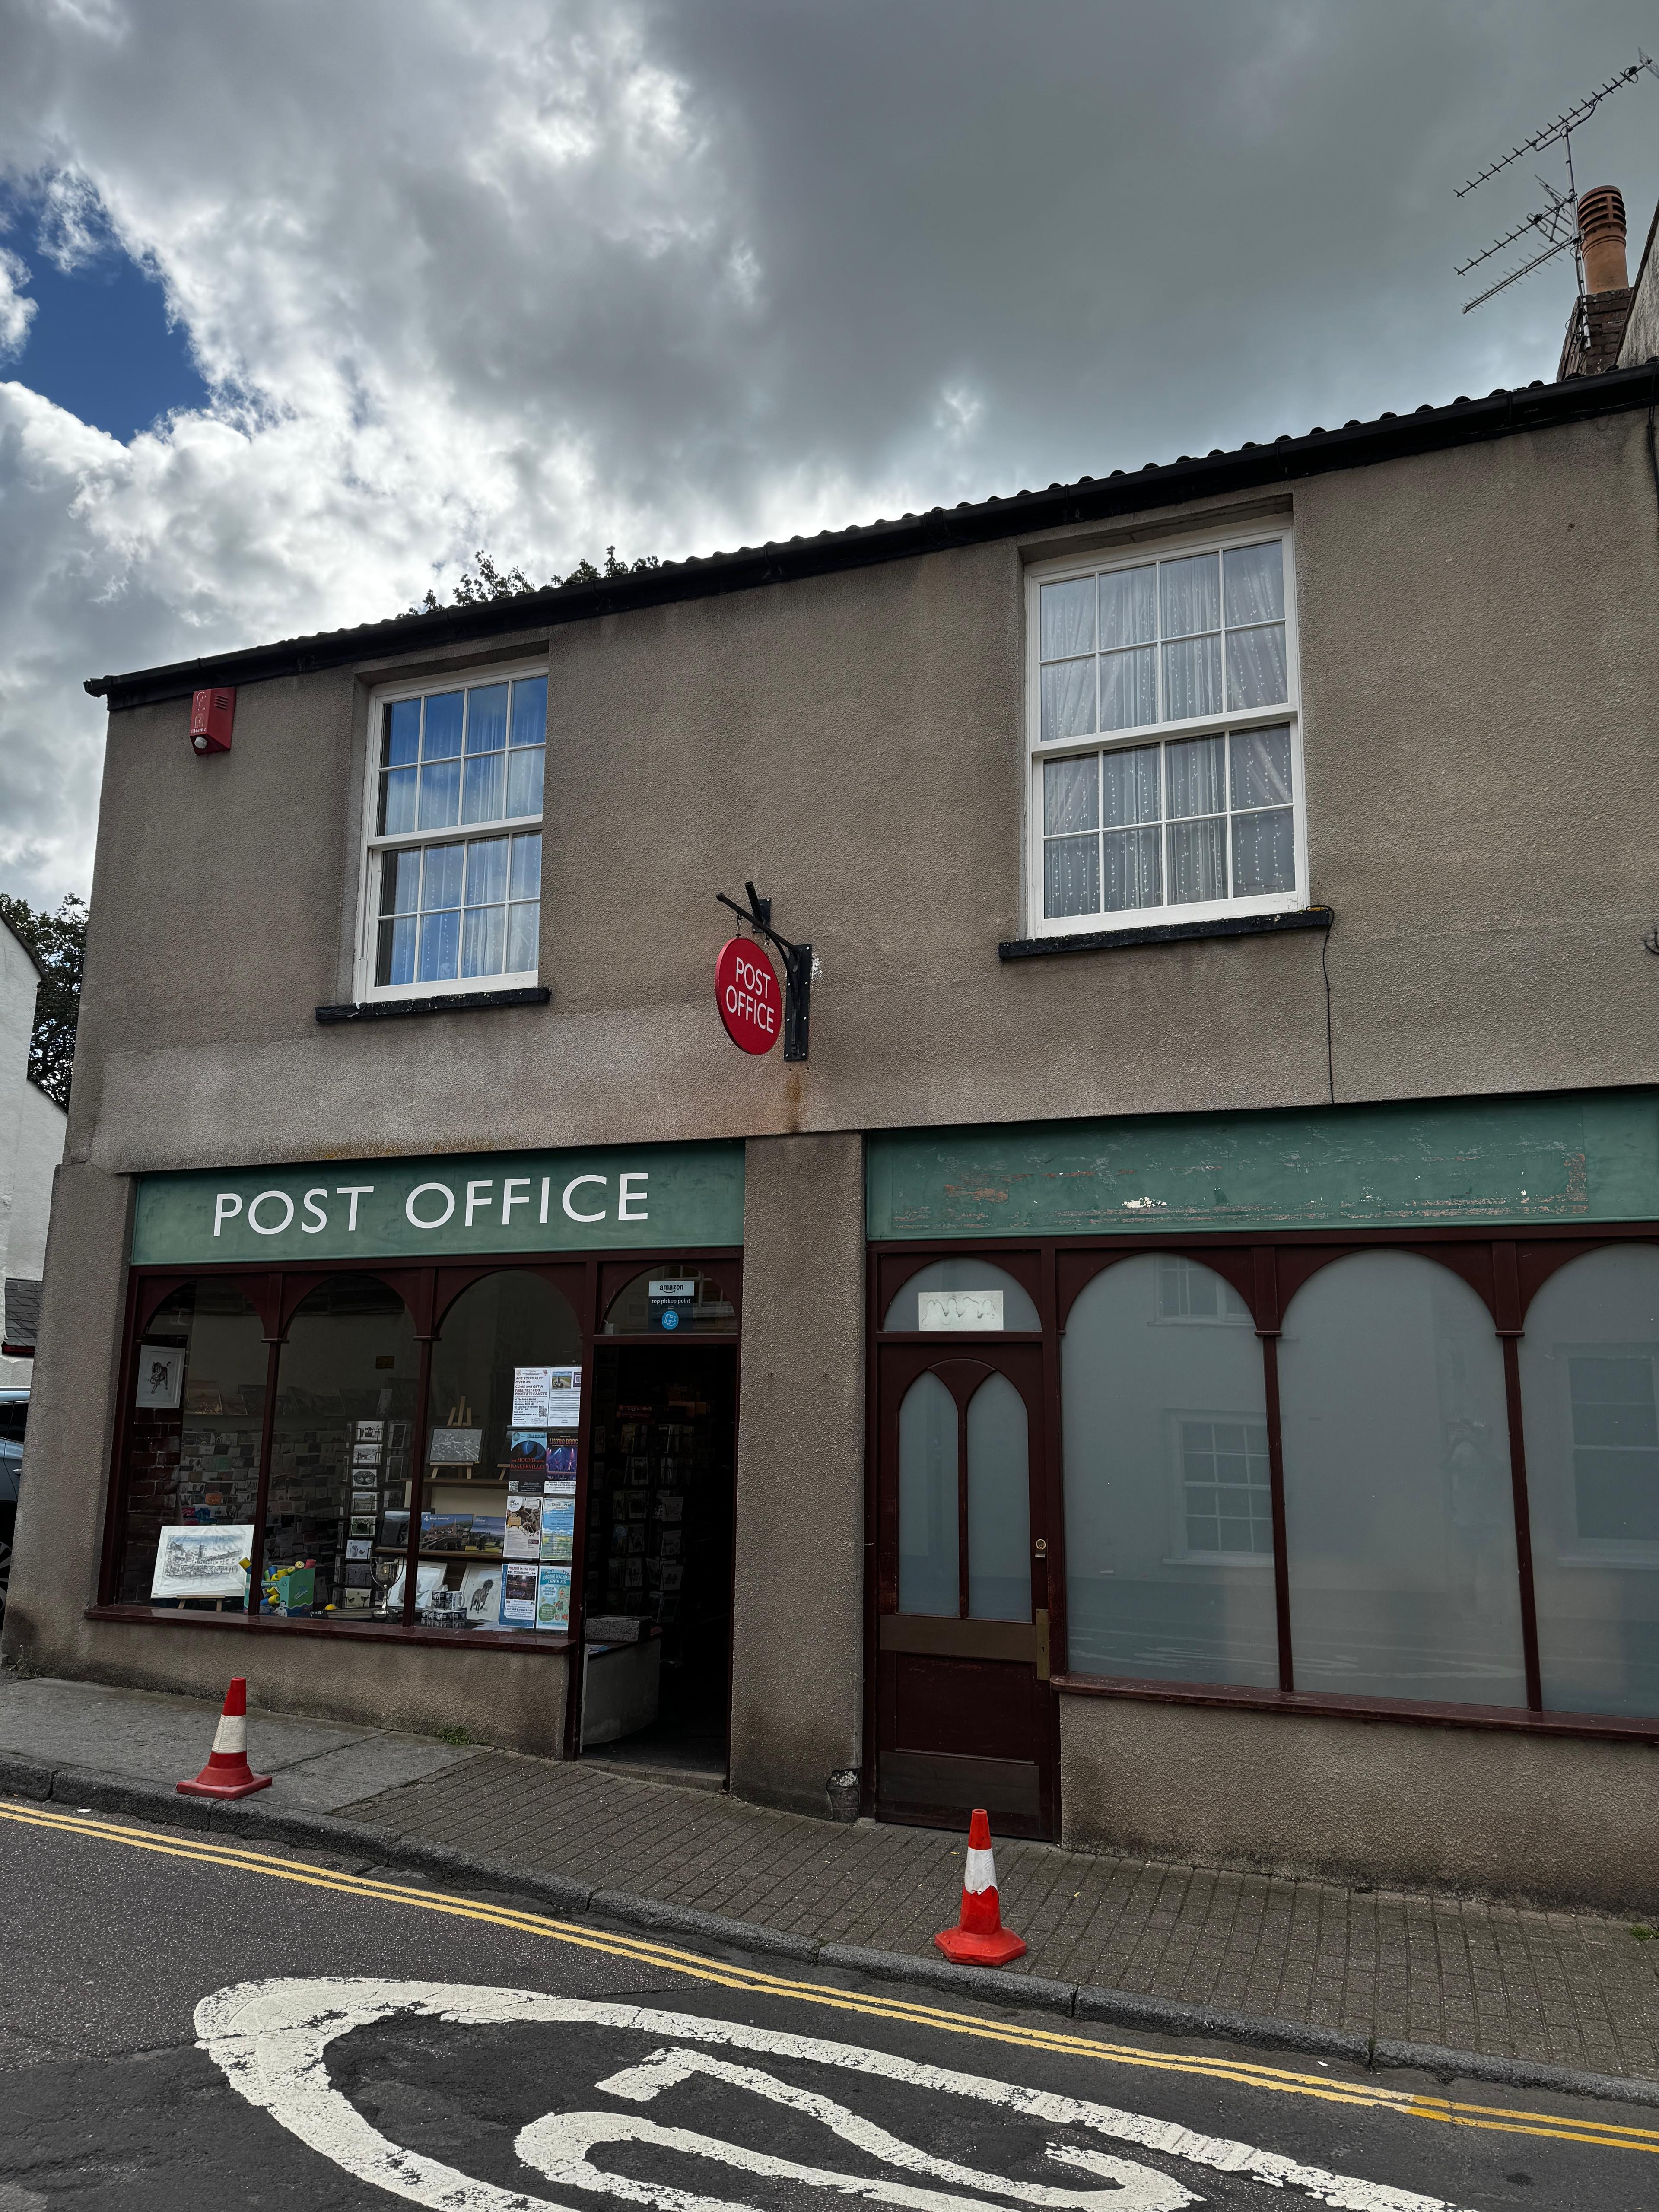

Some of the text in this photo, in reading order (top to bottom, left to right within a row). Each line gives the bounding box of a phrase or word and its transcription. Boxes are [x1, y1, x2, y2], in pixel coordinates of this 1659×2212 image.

[735, 957, 771, 999] POST
[725, 986, 774, 1033] OFFICE
[213, 1171, 649, 1237] POST OFFICE
